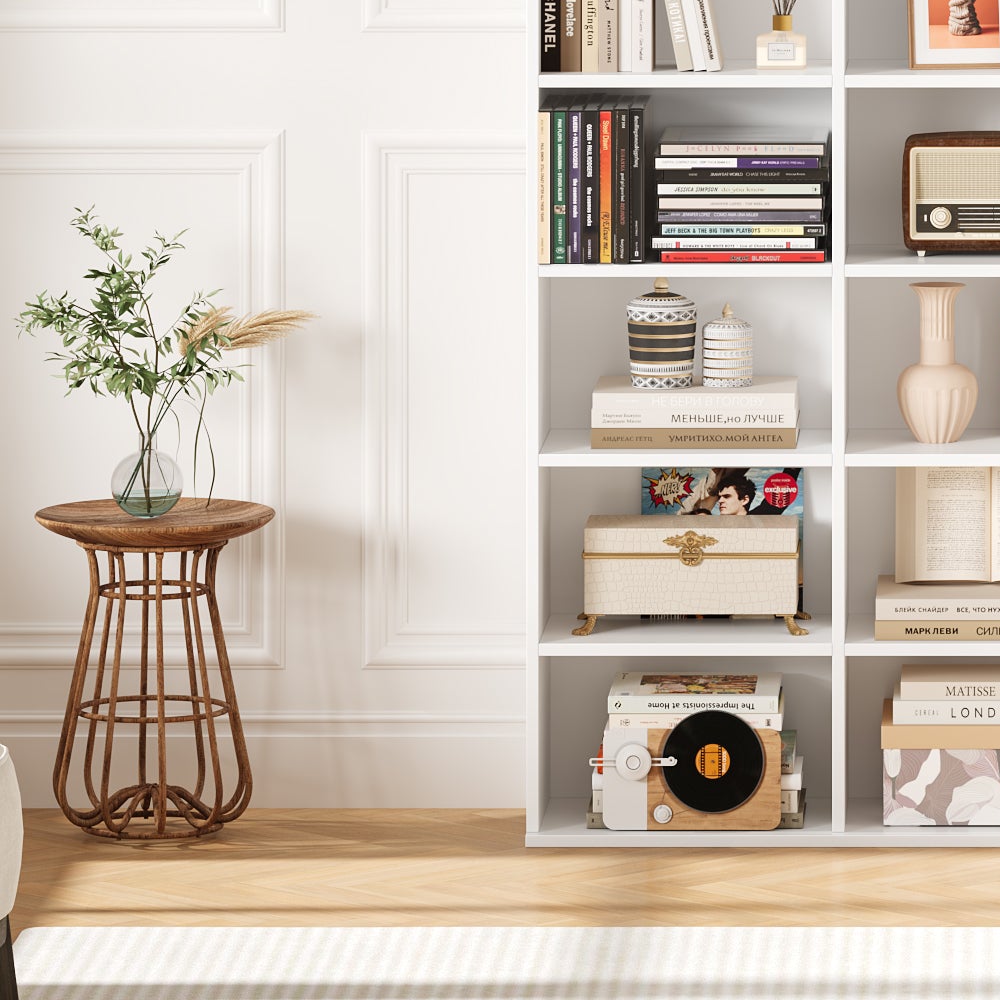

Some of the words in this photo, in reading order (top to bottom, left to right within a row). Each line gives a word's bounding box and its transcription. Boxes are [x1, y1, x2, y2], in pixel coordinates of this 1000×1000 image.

[668, 2, 686, 43] КОТИКА!
[602, 120, 610, 134] Steel
[602, 135, 610, 151] Dawn
[670, 397, 703, 407] БЕРИ
[743, 414, 785, 424] ЛУЧШЕ
[751, 435, 784, 443] АНГЕЛ
[764, 486, 797, 494] exclusive
[918, 606, 949, 614] СНАЙДЕР
[905, 627, 932, 635] МАРК
[932, 627, 959, 635] ЛЕВИ
[945, 686, 996, 697] MATISSE
[647, 702, 670, 710] Home
[682, 701, 739, 710] Impressionists
[740, 702, 755, 710] The
